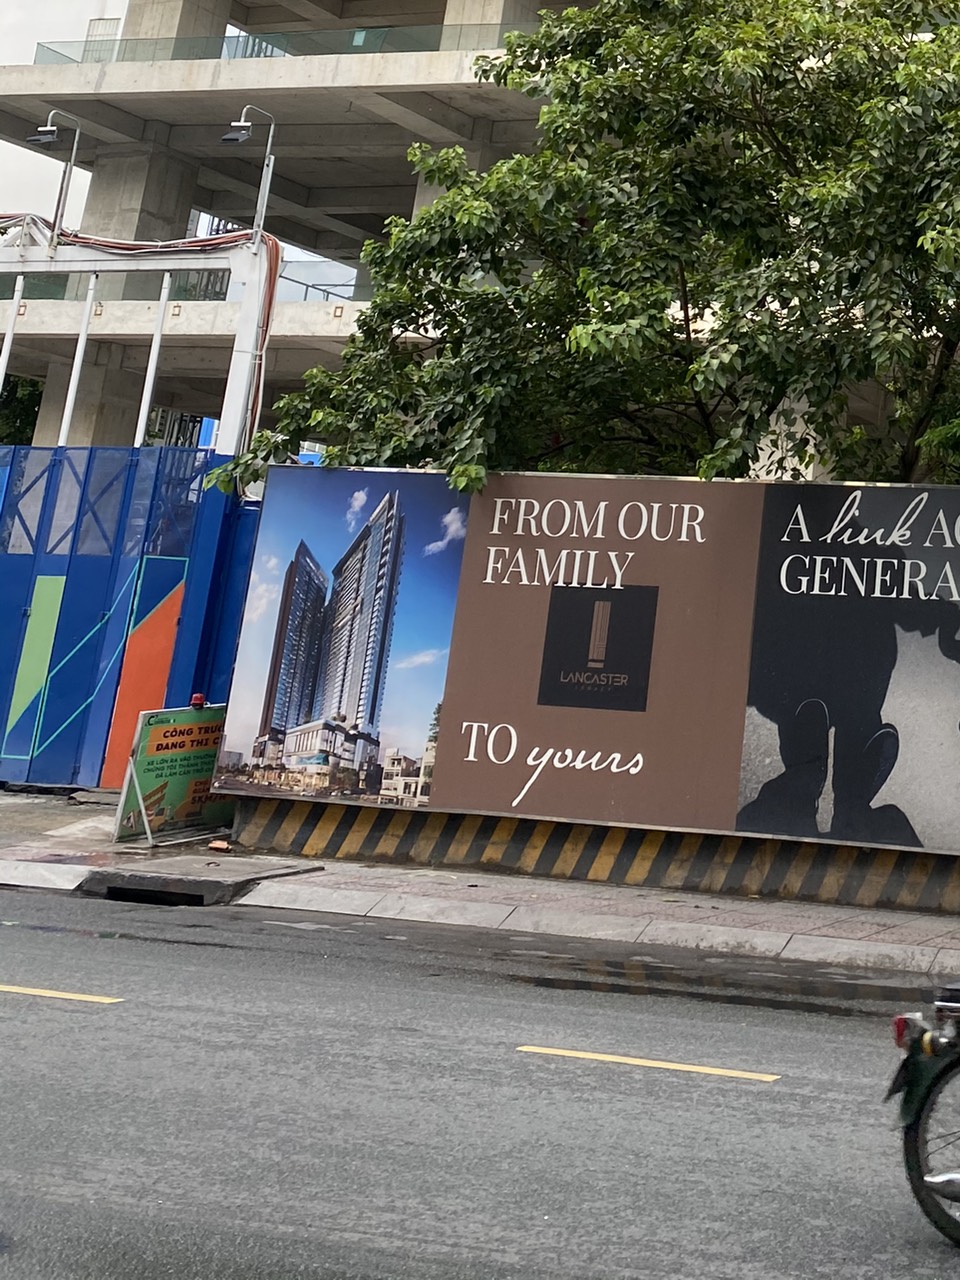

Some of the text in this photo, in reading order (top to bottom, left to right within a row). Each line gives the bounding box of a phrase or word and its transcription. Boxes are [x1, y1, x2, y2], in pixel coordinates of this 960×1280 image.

[489, 498, 706, 543] FROM OUR
[781, 503, 812, 543] A
[819, 490, 929, 546] link
[482, 546, 635, 590] FAMILY
[560, 670, 629, 686] LANCASTER
[155, 740, 186, 752] ĐANG
[189, 738, 209, 747] THI
[163, 728, 194, 739] CÔNG
[461, 722, 644, 807] TO yours
